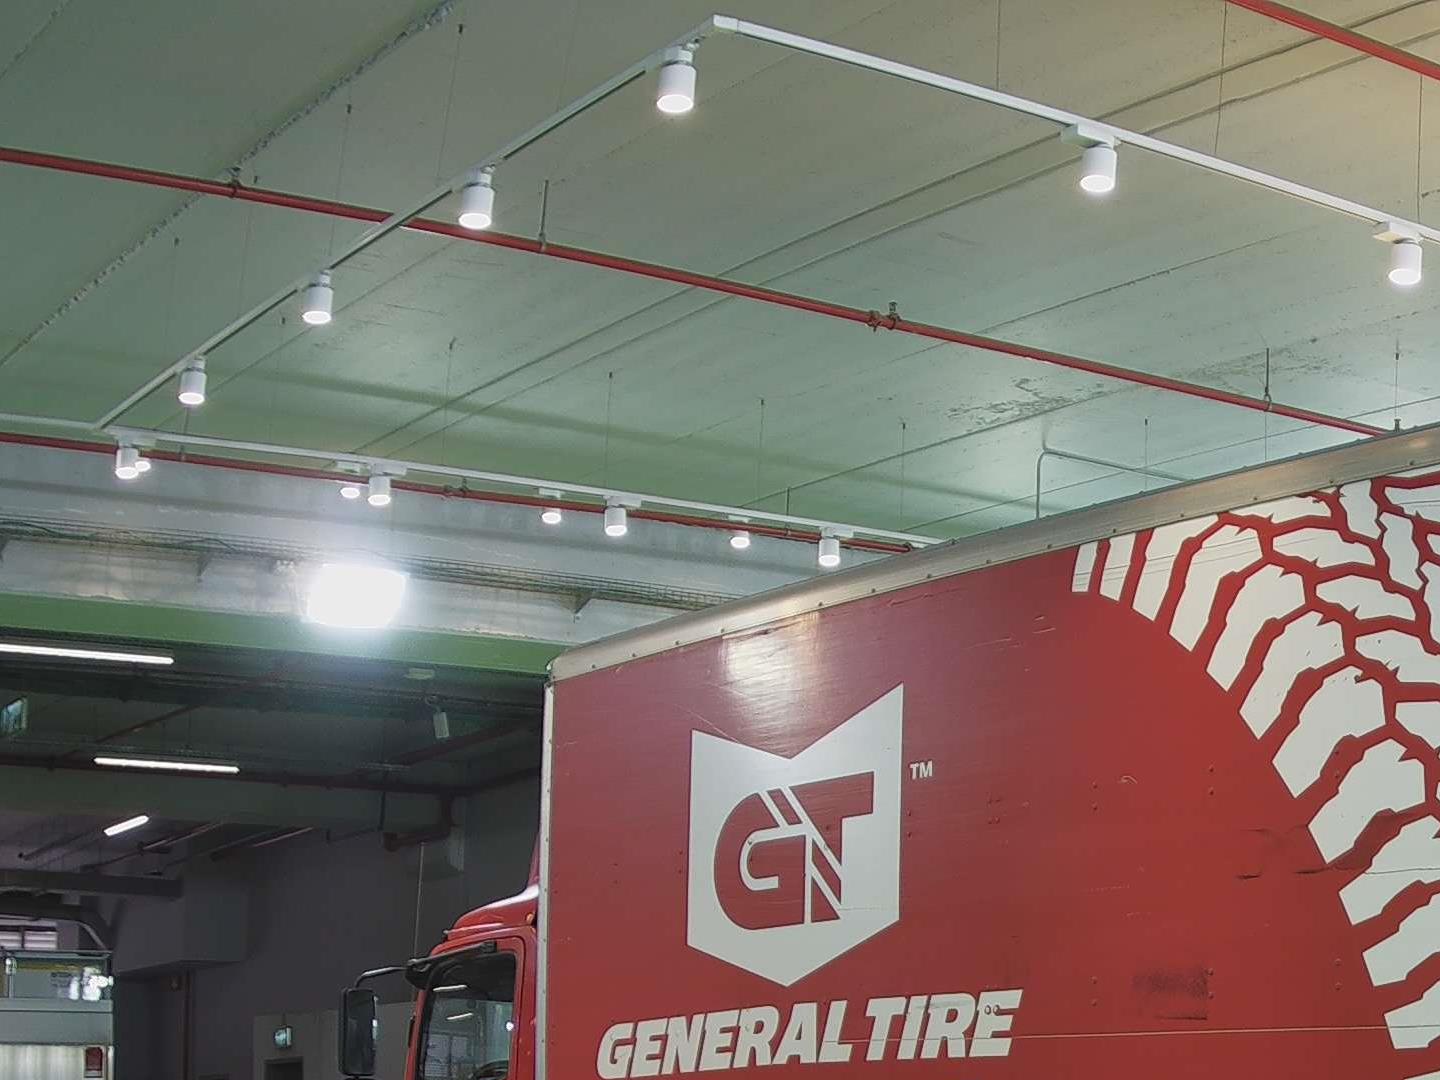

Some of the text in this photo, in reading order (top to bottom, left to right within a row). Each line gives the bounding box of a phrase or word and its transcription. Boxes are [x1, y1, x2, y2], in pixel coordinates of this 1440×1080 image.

[909, 760, 933, 780] TM
[597, 989, 1024, 1080] GENERAL TIRE
